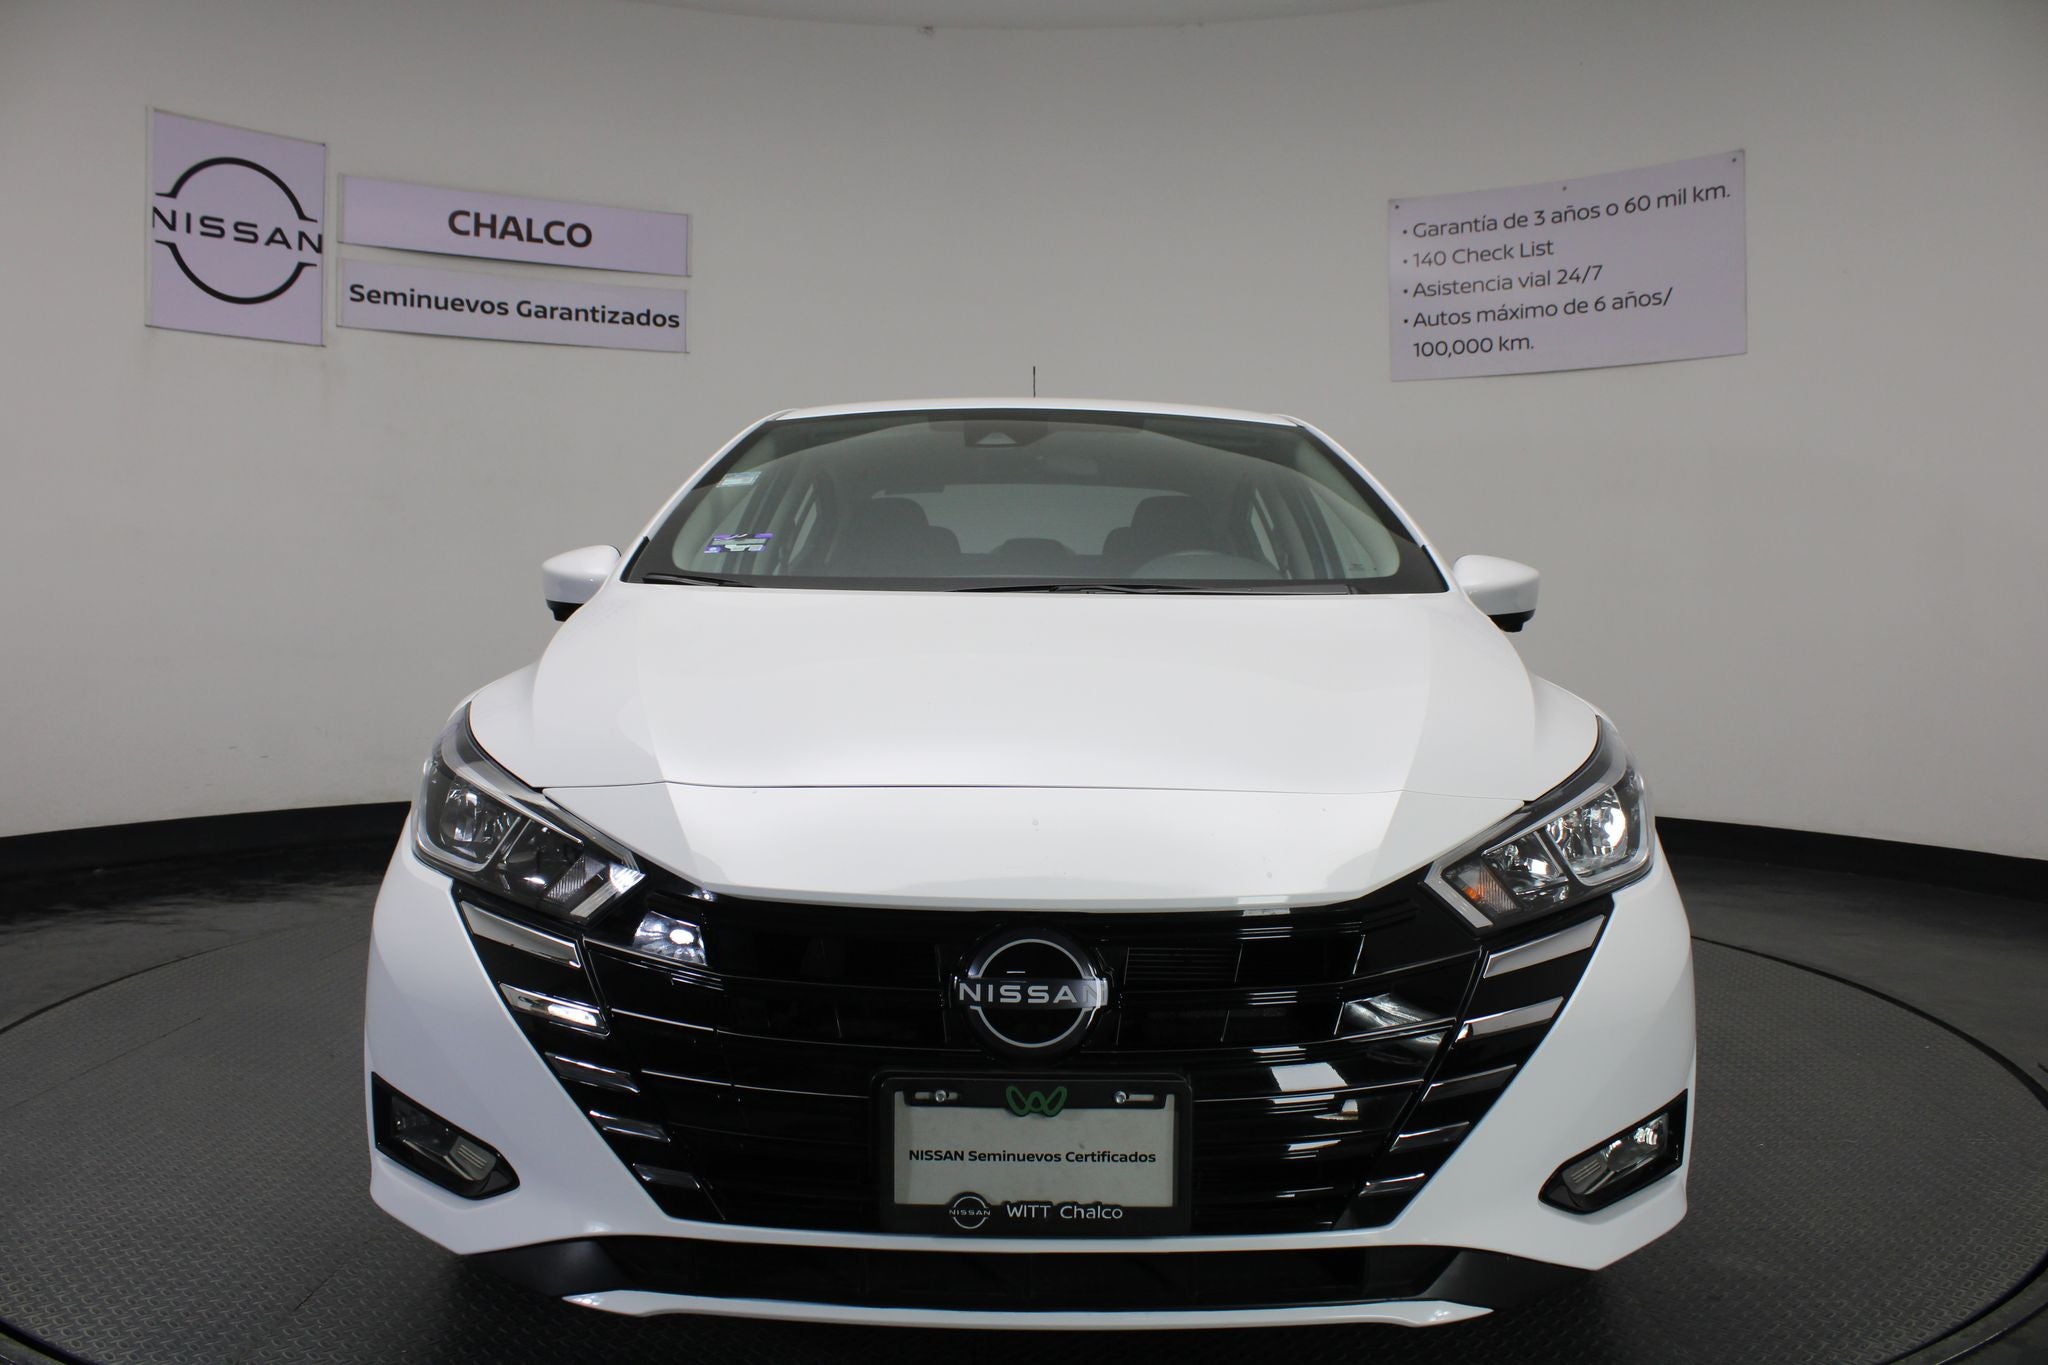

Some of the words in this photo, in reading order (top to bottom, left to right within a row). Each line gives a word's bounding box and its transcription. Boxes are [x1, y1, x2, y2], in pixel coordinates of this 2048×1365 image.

[448, 209, 593, 248] CHALCO
[1413, 214, 1498, 238] Garantía
[1503, 212, 1528, 229] de
[1534, 210, 1545, 226] 3
[1551, 205, 1601, 224] años
[1606, 203, 1619, 217] o
[1624, 194, 1651, 214] 60
[1656, 188, 1687, 209] mil
[1693, 183, 1731, 203] km.
[152, 206, 323, 254] NISSAN
[1413, 251, 1447, 268] 140
[1452, 244, 1514, 265] Check
[1520, 240, 1554, 258] List
[1412, 275, 1513, 298] Asistencia
[1518, 270, 1551, 288] vial
[1557, 265, 1603, 285] 24/7
[349, 283, 509, 316] Seminuevos
[516, 300, 680, 329] Garantizados
[1412, 309, 1472, 328] Autos
[1477, 303, 1558, 323] máximo
[1563, 298, 1589, 315] de
[1594, 296, 1606, 312] 6
[1612, 287, 1673, 311] años/
[1413, 338, 1493, 358] 100,000
[1499, 335, 1534, 352] km.
[909, 1150, 965, 1161] NISSAN
[968, 1150, 1062, 1163] Seminuevos
[1065, 1151, 1156, 1163] Certificados
[1006, 1204, 1051, 1218] WITT
[1059, 1205, 1123, 1219] Chalco
